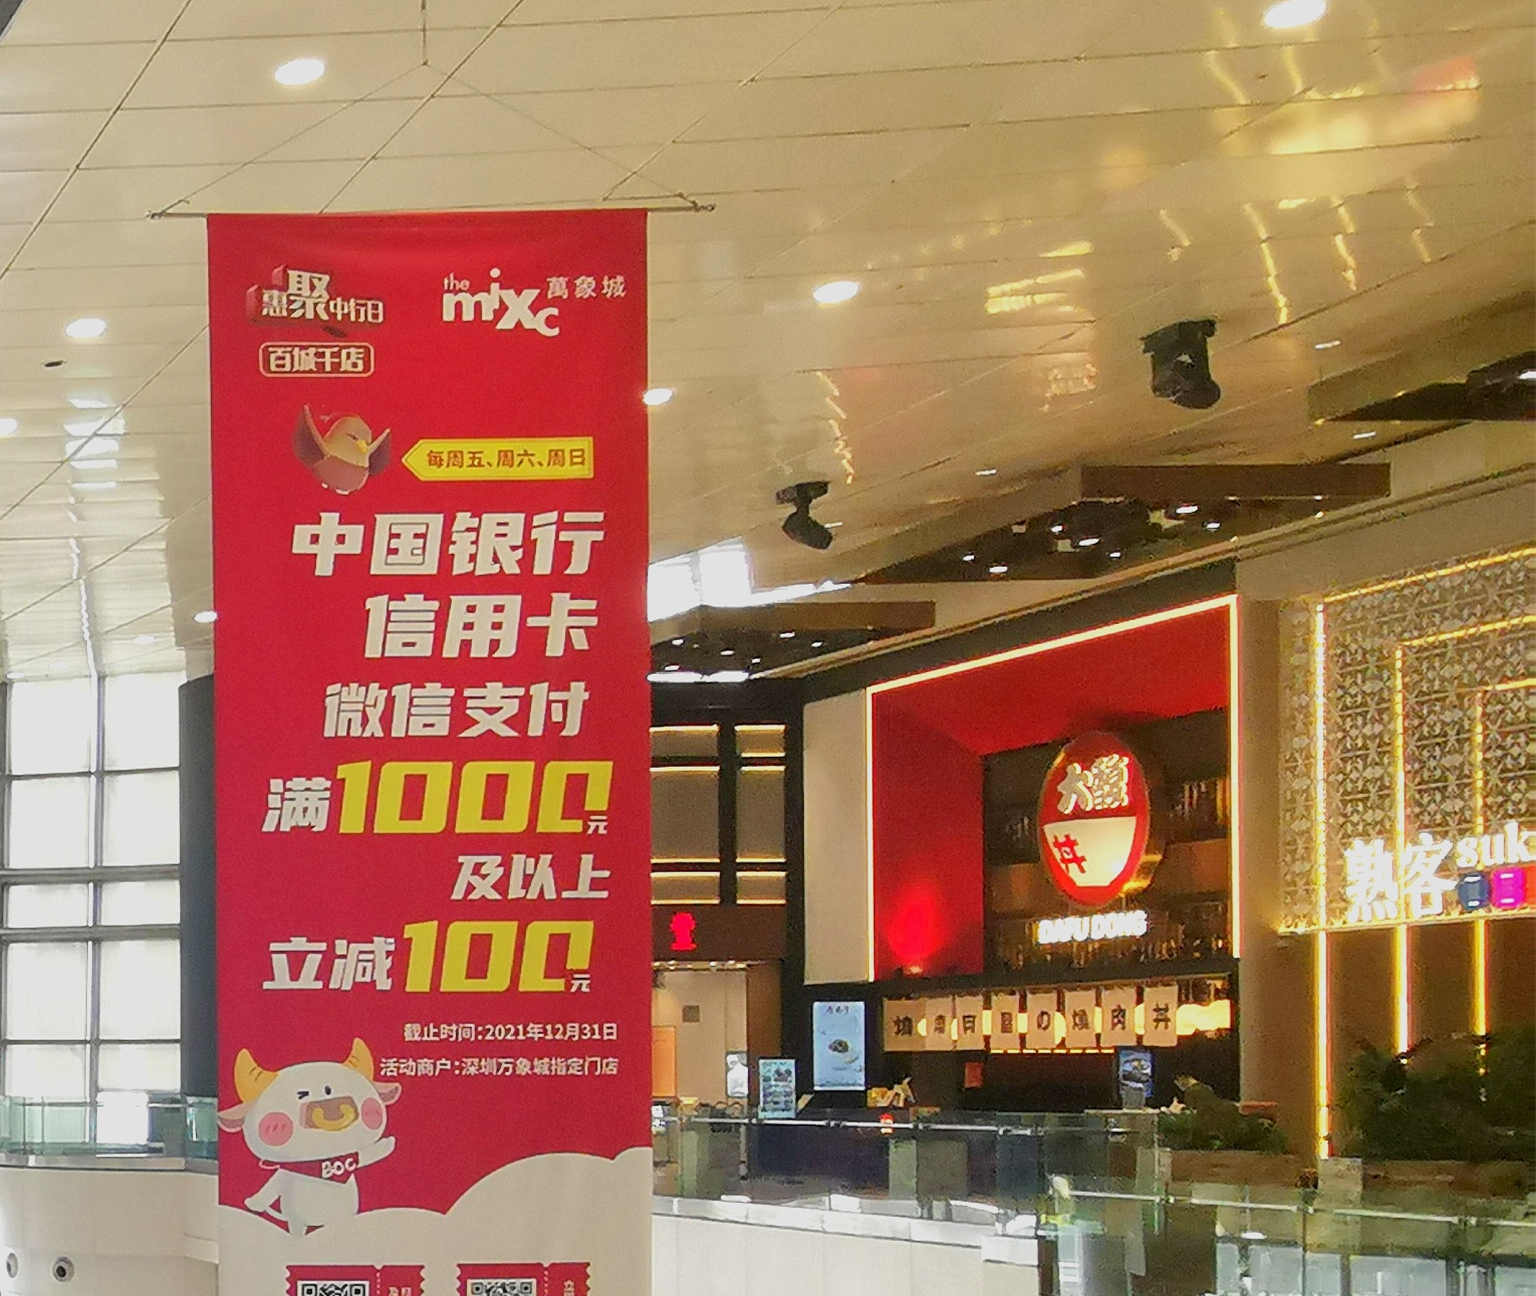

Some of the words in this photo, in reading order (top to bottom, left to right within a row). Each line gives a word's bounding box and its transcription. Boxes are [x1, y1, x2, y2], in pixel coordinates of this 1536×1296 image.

[443, 273, 470, 291] the
[546, 275, 627, 300] 萬象城
[268, 347, 365, 373] 百城千店
[427, 448, 586, 470] 每周五、周六、周日
[291, 510, 605, 577] 中国银行
[363, 592, 599, 660] 信用卡
[322, 681, 591, 738] 微信支付
[451, 853, 610, 901] 及以上
[1343, 832, 1458, 923] 熟客
[321, 1154, 358, 1181] BOC
